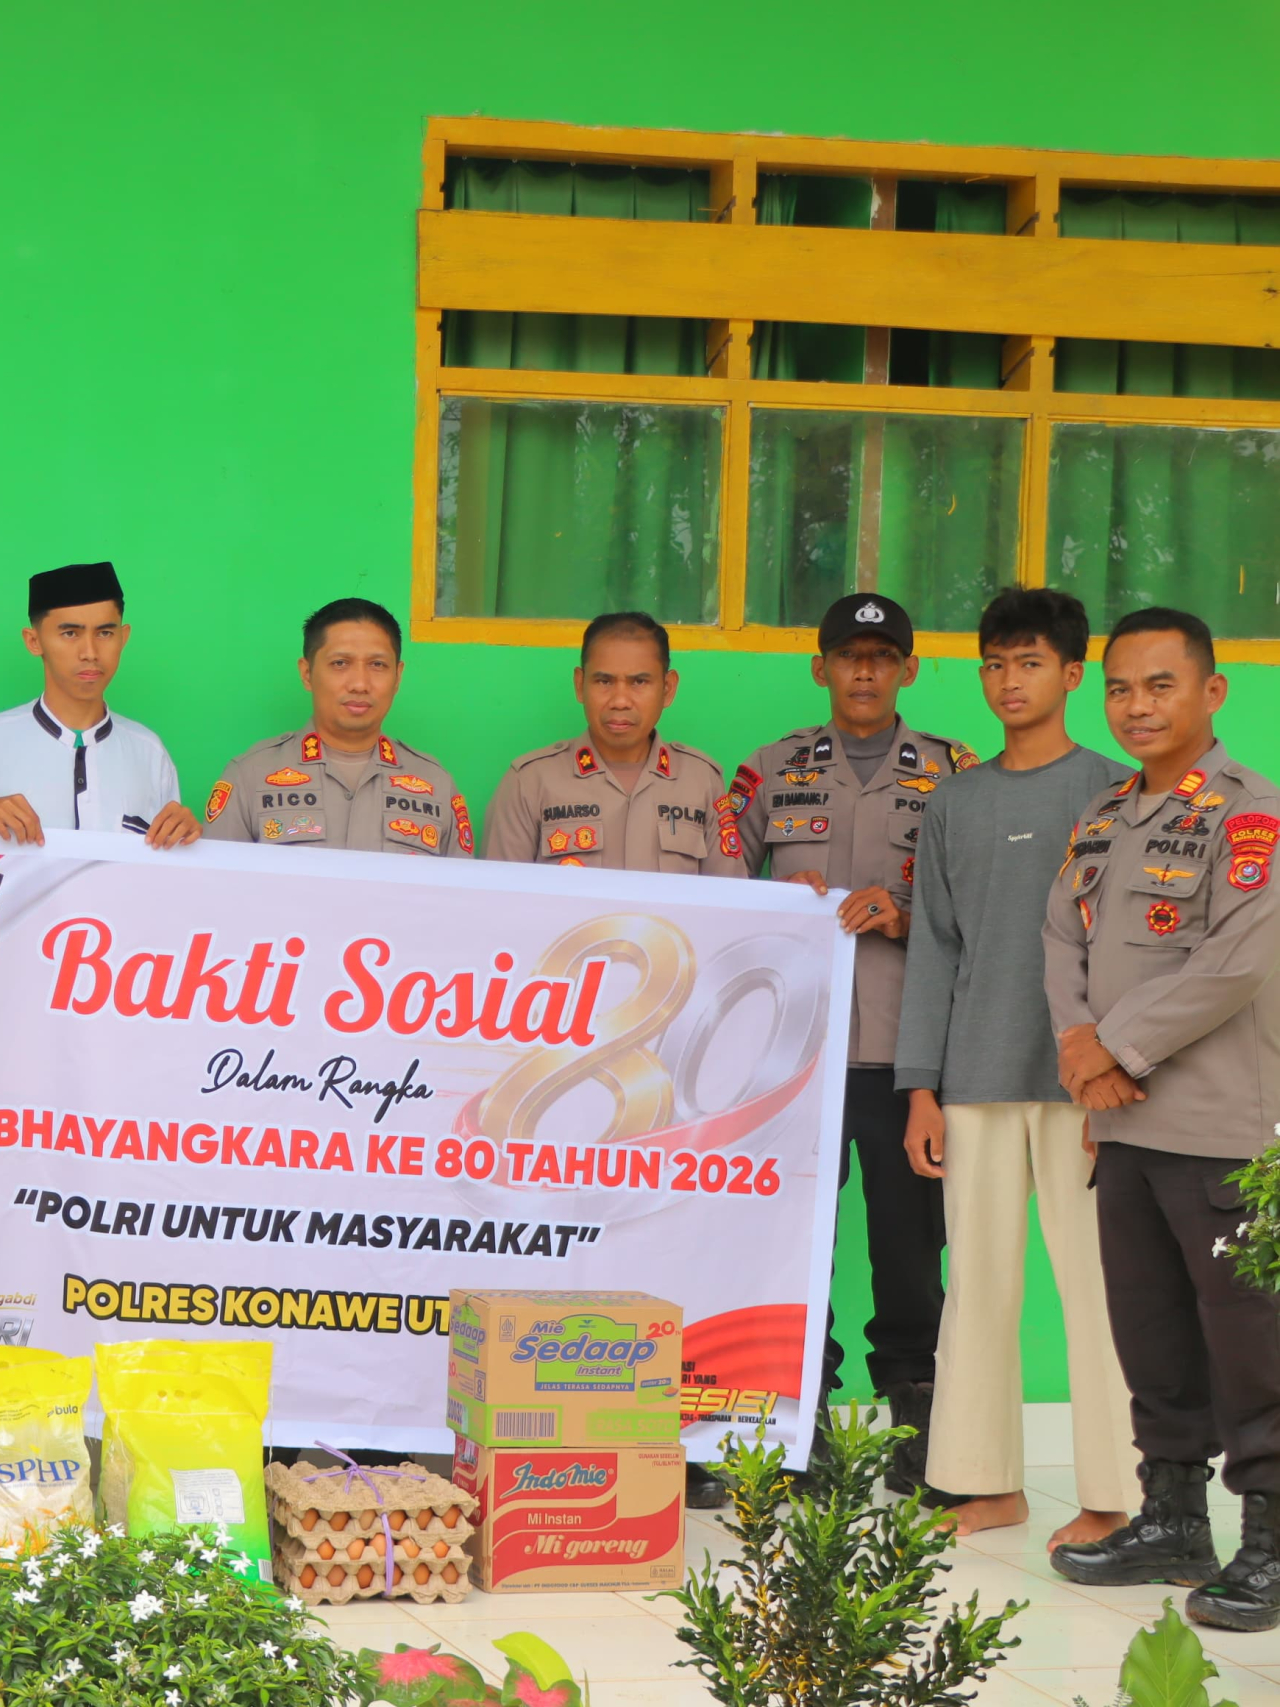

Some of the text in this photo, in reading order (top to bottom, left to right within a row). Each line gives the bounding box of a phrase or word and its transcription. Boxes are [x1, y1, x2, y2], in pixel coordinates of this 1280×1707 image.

[262, 793, 317, 808] RICO
[386, 796, 440, 818] POLRI
[1228, 815, 1277, 829] PELOPOR
[1145, 839, 1207, 859] POLRI
[42, 917, 608, 1047] Bakti Sosial
[202, 1048, 433, 1124] Dalam Rangka
[367, 1135, 425, 1176] KE
[434, 1138, 496, 1181] 80
[506, 1143, 662, 1190] TAHUN
[670, 1152, 781, 1197] 2026
[162, 1204, 300, 1243] UNTUK
[64, 1275, 450, 1335] POLRES KONAWE UT
[532, 1321, 565, 1336] Mie
[512, 1334, 657, 1368] Sedaap
[576, 1365, 622, 1376] Instant
[694, 1374, 717, 1385] YANG
[540, 1383, 561, 1391] JELAS
[564, 1382, 590, 1391] TERASA
[593, 1382, 630, 1391] SEDAPNYA
[680, 1387, 779, 1414] ESISI
[528, 1513, 582, 1525] Mi Instan
[524, 1535, 650, 1560] Mi goreng
